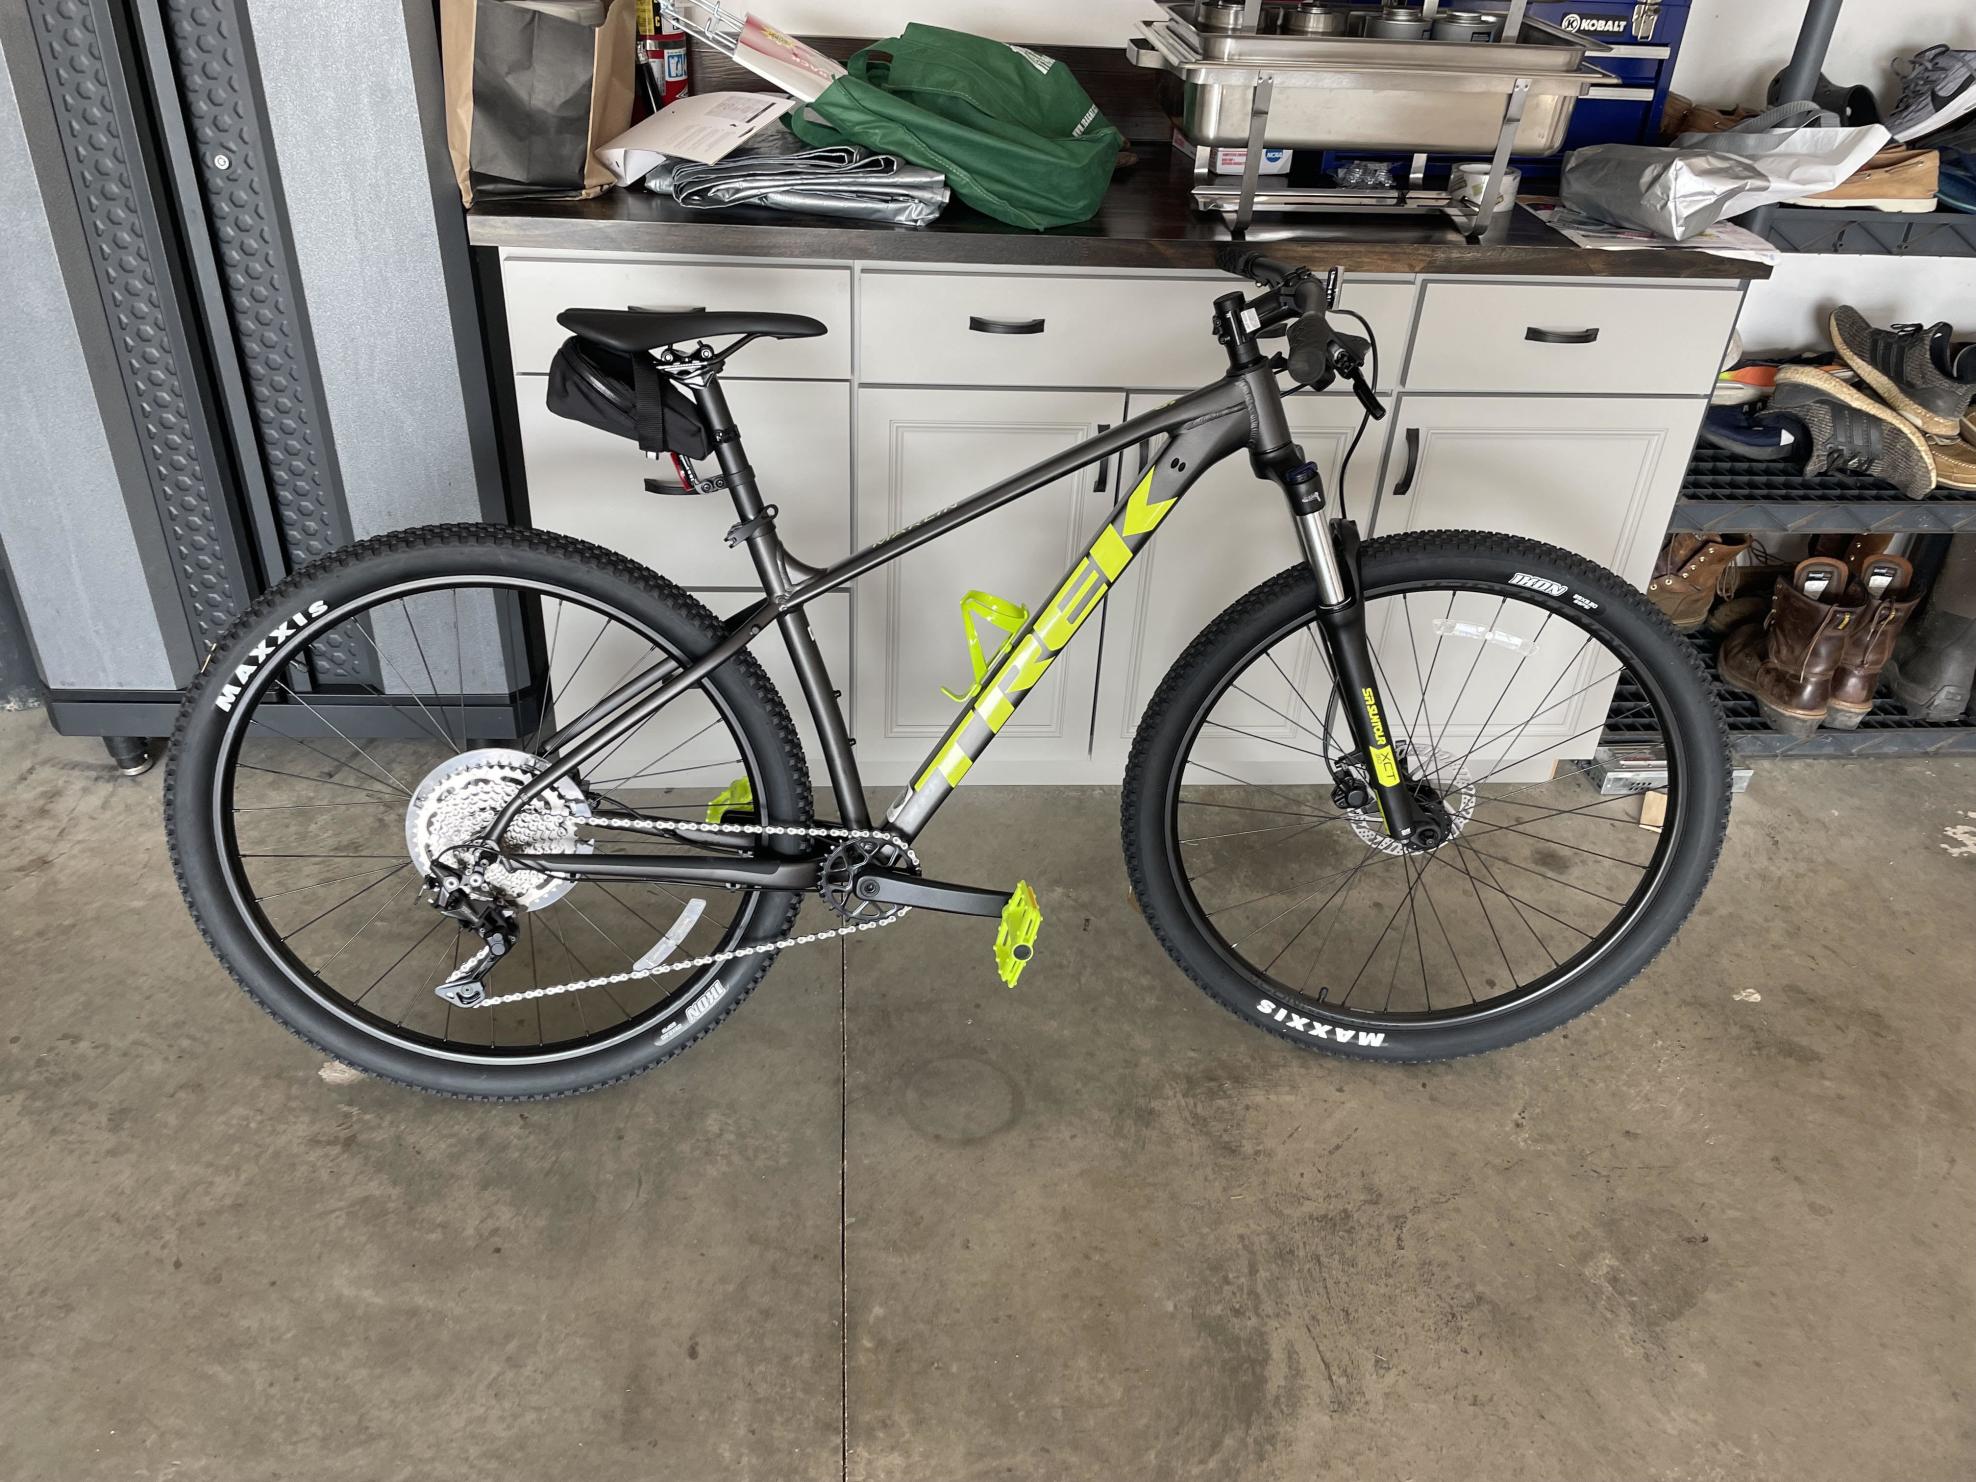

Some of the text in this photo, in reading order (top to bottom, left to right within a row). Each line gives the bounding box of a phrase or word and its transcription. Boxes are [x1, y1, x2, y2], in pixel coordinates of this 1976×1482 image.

[1580, 18, 1627, 32] KOBALT
[1508, 572, 1569, 597] IKON
[913, 463, 1179, 793] TREK
[215, 600, 328, 713] MAXXIS
[1361, 687, 1387, 746] SR SUNTOUR
[1380, 751, 1397, 781] XCT
[685, 979, 727, 1024] IKON
[1256, 999, 1386, 1048] MAXXIS
